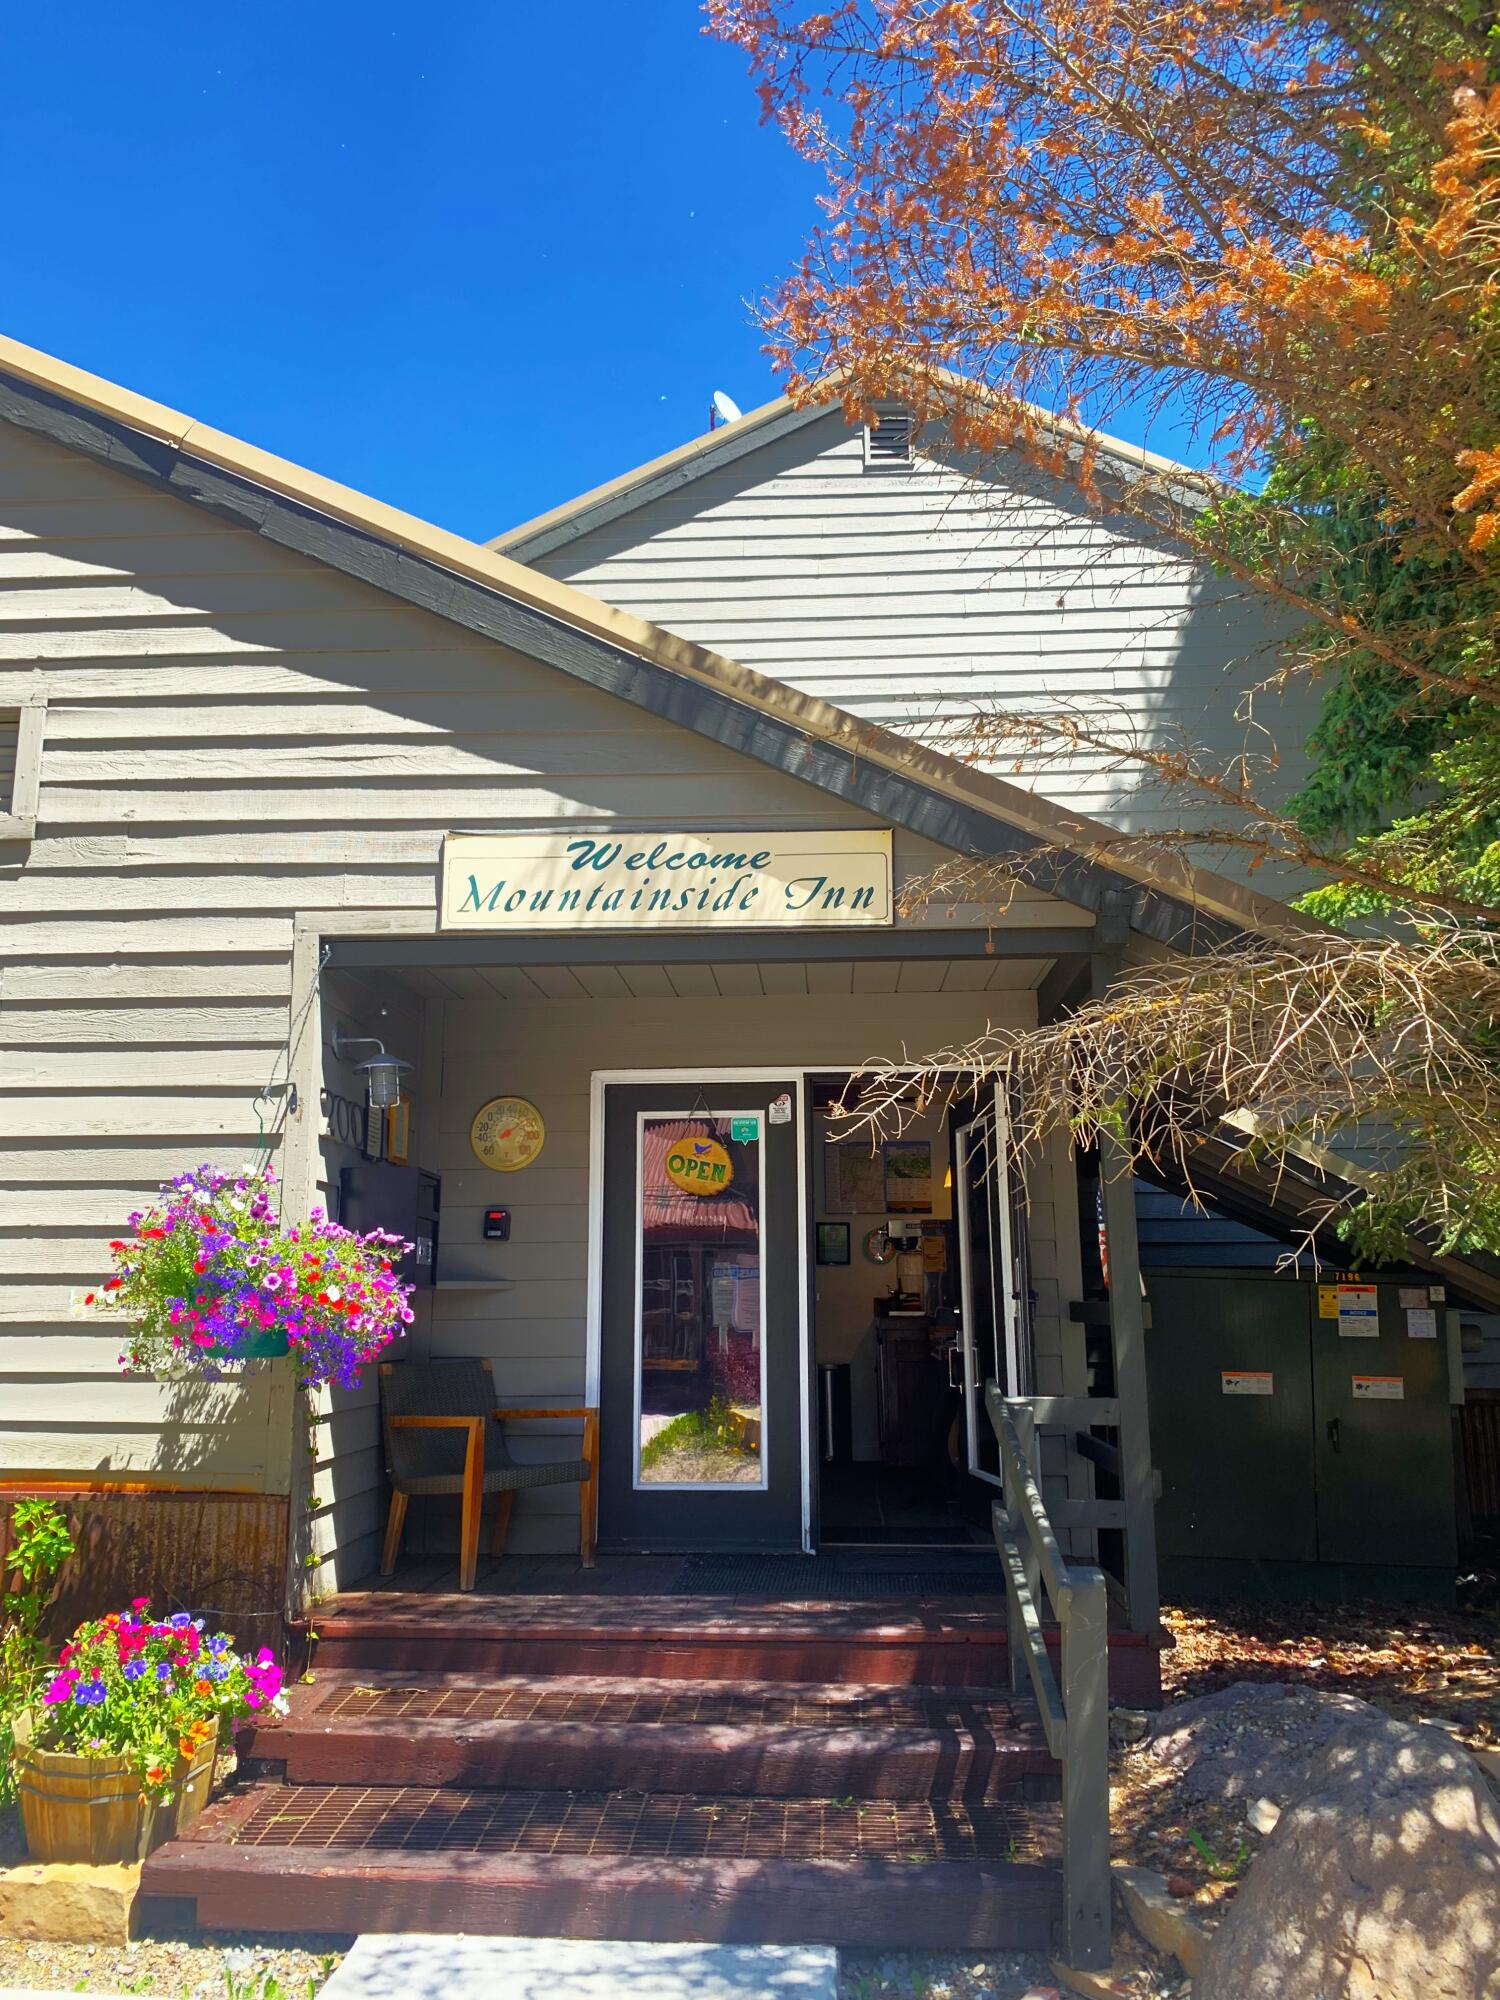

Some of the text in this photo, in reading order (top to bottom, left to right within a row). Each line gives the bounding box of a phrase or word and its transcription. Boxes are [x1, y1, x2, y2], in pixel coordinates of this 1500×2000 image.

[565, 839, 772, 872] Welcome
[457, 873, 876, 913] Mountainside Inn
[487, 1111, 494, 1122] 0
[668, 1154, 727, 1184] OPEN
